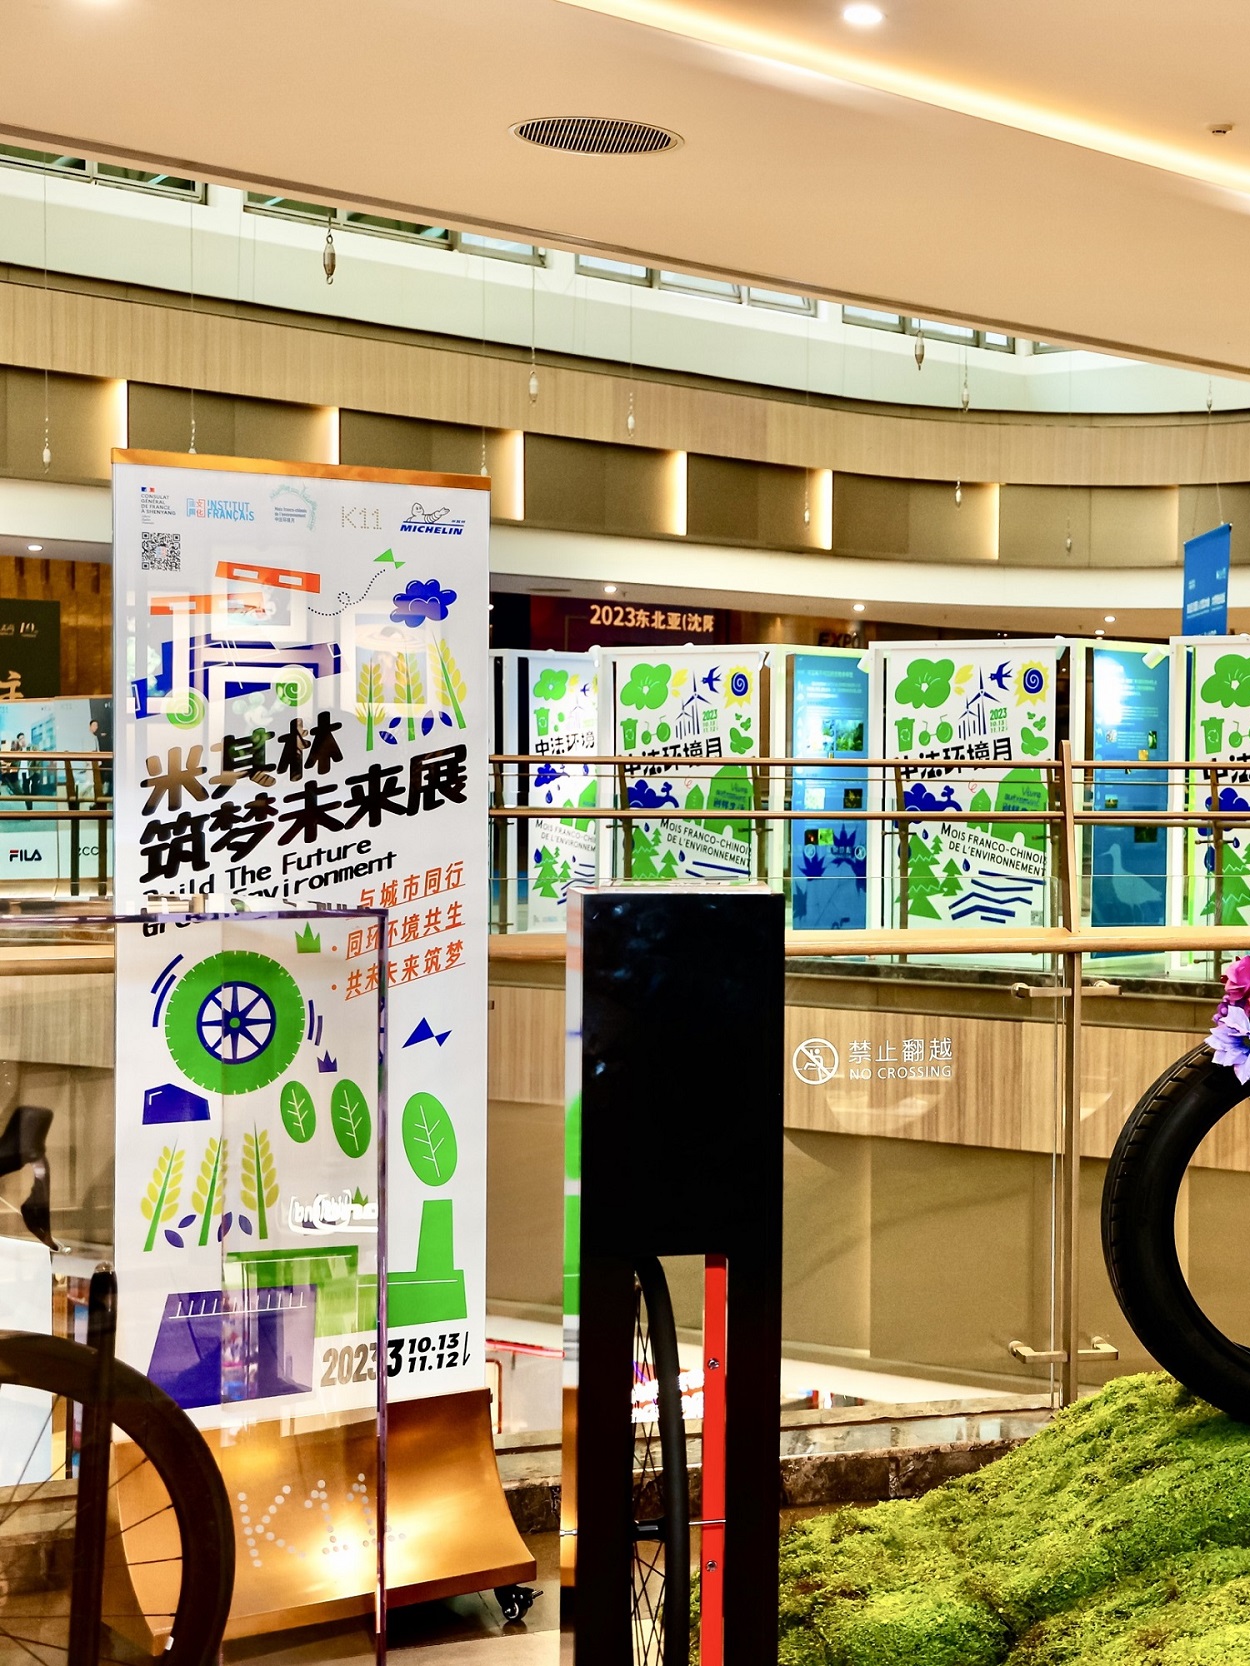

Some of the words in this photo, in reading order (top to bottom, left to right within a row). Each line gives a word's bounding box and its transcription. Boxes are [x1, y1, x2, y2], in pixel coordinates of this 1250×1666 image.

[207, 500, 250, 512] INSTITUT
[341, 506, 382, 530] K11
[400, 525, 464, 535] MICHELIN
[140, 711, 344, 817] 米其林
[140, 744, 468, 884] 筑梦未来展
[666, 832, 680, 843] DE
[949, 840, 960, 852] DE
[9, 849, 42, 862] FILA
[225, 865, 272, 890] The
[282, 839, 372, 875] Future
[360, 861, 463, 908] 与城市同行
[848, 1037, 953, 1064] 禁止翻越
[849, 1068, 872, 1080] NO
[877, 1065, 952, 1079] CROSSING
[408, 1333, 460, 1355] 10.13
[408, 1351, 459, 1373] 11.12
[237, 1472, 406, 1568] K11
